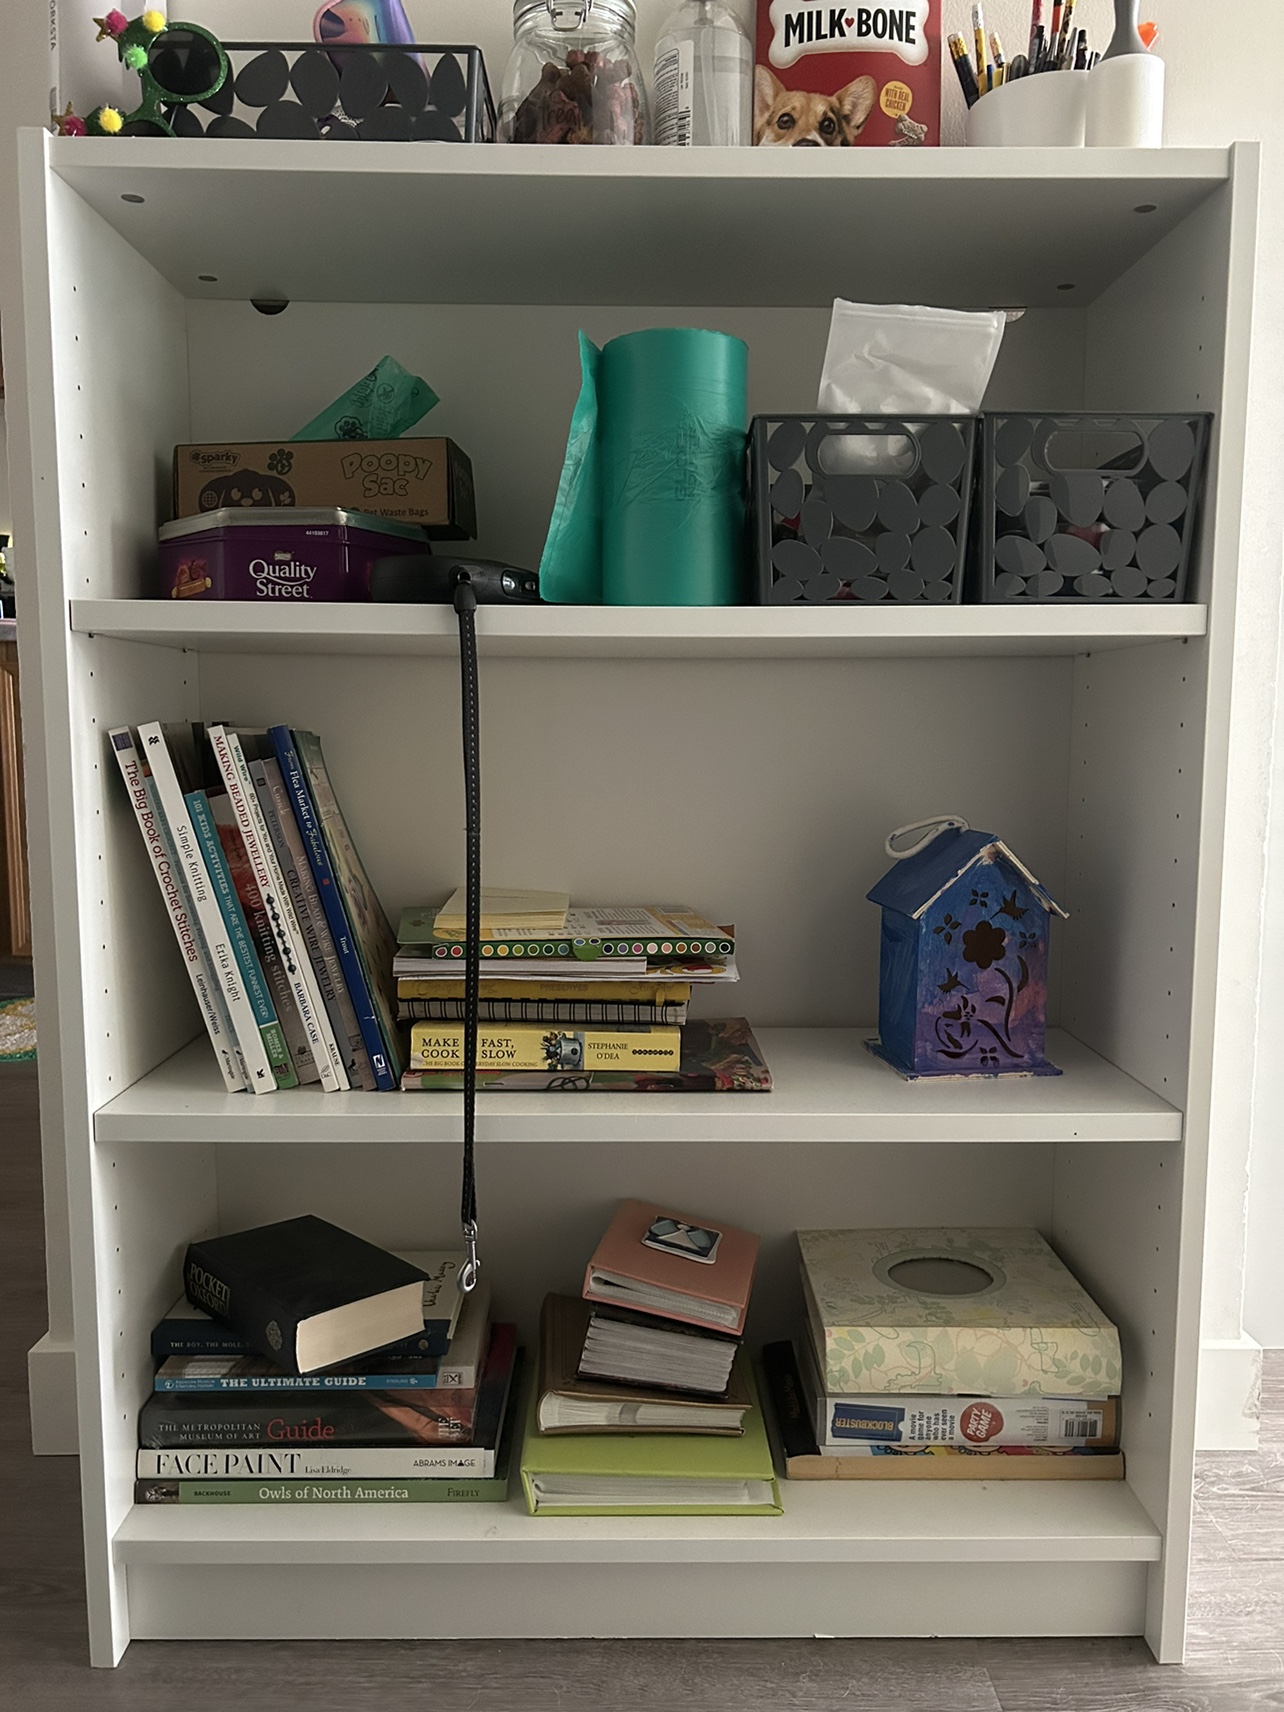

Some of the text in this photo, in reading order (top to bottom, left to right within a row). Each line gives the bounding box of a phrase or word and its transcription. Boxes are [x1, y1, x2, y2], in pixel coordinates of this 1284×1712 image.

[784, 8, 916, 48] MILK BONE
[885, 88, 910, 102] WITH REAL
[885, 98, 907, 112] CHICKEN
[200, 452, 238, 465] sparky
[340, 452, 433, 481] Poopy
[362, 473, 409, 498] Sac
[380, 508, 406, 517] Waste
[408, 507, 429, 517] Bags
[248, 558, 318, 583] Quality
[256, 579, 310, 599] Street
[232, 744, 243, 763] Wild
[290, 770, 300, 788] Flea
[295, 789, 310, 820] Market
[191, 798, 201, 813] 101
[213, 735, 235, 781] MAKING
[229, 783, 250, 828] BEADED
[242, 829, 270, 887] JEWELLERY
[253, 803, 263, 824] Projects
[196, 812, 210, 839] KIDS
[257, 823, 266, 833] for
[268, 810, 285, 848] PETERSON
[263, 841, 272, 854] and
[125, 760, 198, 962] The Big Book of Crochet Stitches
[176, 825, 207, 903] Simple Knitting
[206, 840, 229, 894] ACTIVITIES
[273, 865, 281, 881] Home
[276, 879, 287, 896] Made
[224, 895, 235, 912] THAT
[281, 894, 291, 908] With
[230, 913, 239, 926] ARE
[284, 906, 294, 920] Wild
[299, 853, 344, 993] MAKING BEAD & WIRE JEWELRY
[232, 925, 243, 939] THE
[286, 869, 336, 1001] CREATIVE WIRE JEWELRY
[245, 883, 293, 1012] 400 knitting stitches
[340, 936, 350, 954] Trout
[215, 943, 229, 969] Erika
[224, 970, 241, 1002] Knight
[245, 967, 262, 999] FUNNEST
[540, 983, 589, 992] PRESERVES
[195, 973, 220, 1035] Leinhauser/Weiss
[294, 982, 319, 1044] BARBARA CASE
[264, 1030, 279, 1058] MILLER
[421, 1038, 514, 1049] MAKE FAST,
[329, 1043, 340, 1065] KRAUSE
[421, 1049, 517, 1059] COOK SLOW
[596, 1052, 620, 1060] O'DEA
[189, 1262, 229, 1302] POCKET
[170, 1340, 184, 1348] THE
[220, 1376, 367, 1388] THE ULTIMATE GUIDE
[158, 1423, 261, 1432] THE METROPOLITAN
[266, 1417, 335, 1441] Guide
[835, 1417, 894, 1431] BLOCKBUSTER
[909, 1413, 917, 1434] movie
[925, 1416, 933, 1441] anyone
[966, 1407, 981, 1436] PARTY
[975, 1408, 992, 1439] GAME
[228, 1432, 238, 1440] OF
[242, 1432, 261, 1440] ART
[932, 1427, 940, 1441] who
[155, 1453, 476, 1476] FACE PAINT Lisa Eldridge ABRAMS IMAGE
[259, 1486, 292, 1499] Owls
[294, 1486, 311, 1499] of
[312, 1486, 351, 1499] North
[355, 1486, 409, 1499] America
[447, 1488, 481, 1497] FIREFLY
